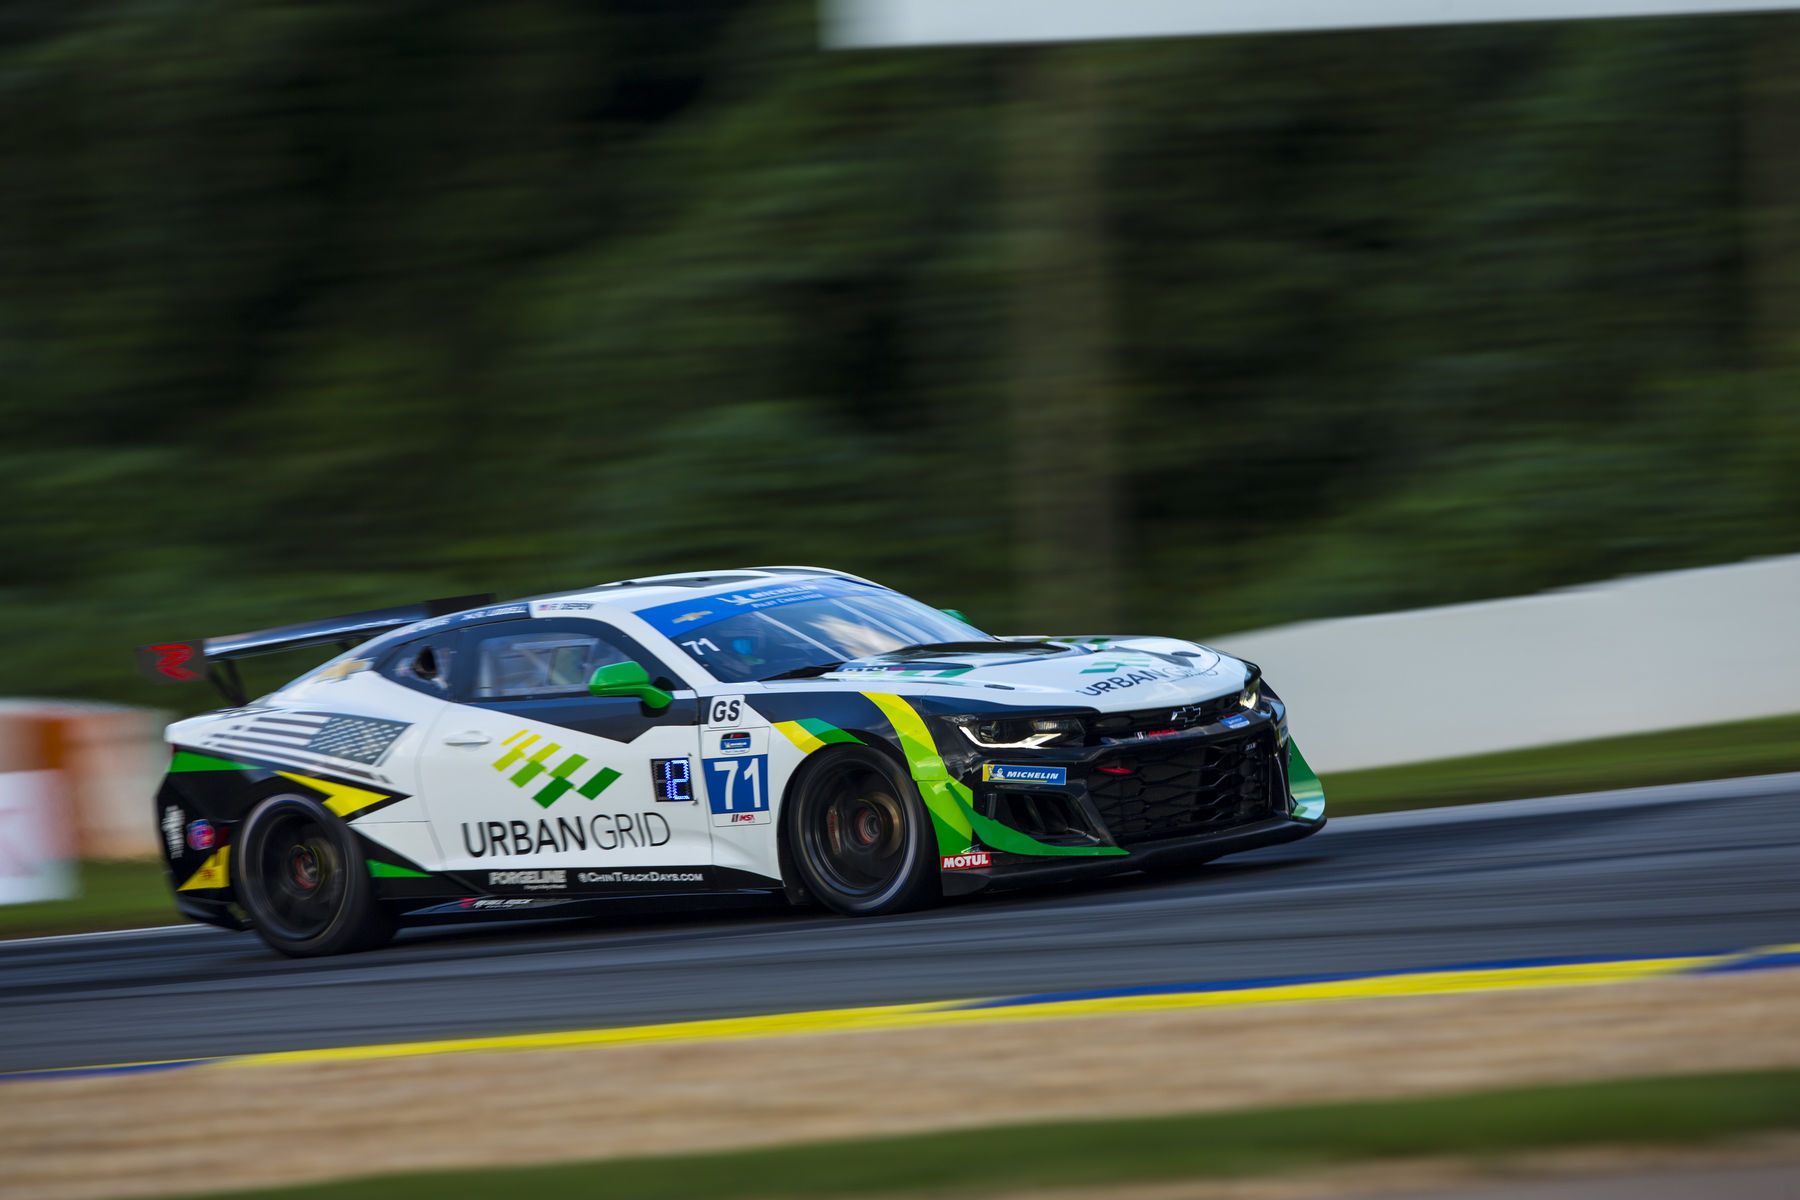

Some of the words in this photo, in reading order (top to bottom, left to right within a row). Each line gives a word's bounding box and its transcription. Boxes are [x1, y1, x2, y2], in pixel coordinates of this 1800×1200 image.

[681, 637, 720, 656] 71
[713, 699, 741, 722] GS
[713, 757, 761, 810] 71
[1006, 770, 1059, 780] MICHELIN
[943, 853, 990, 869] MOTUL
